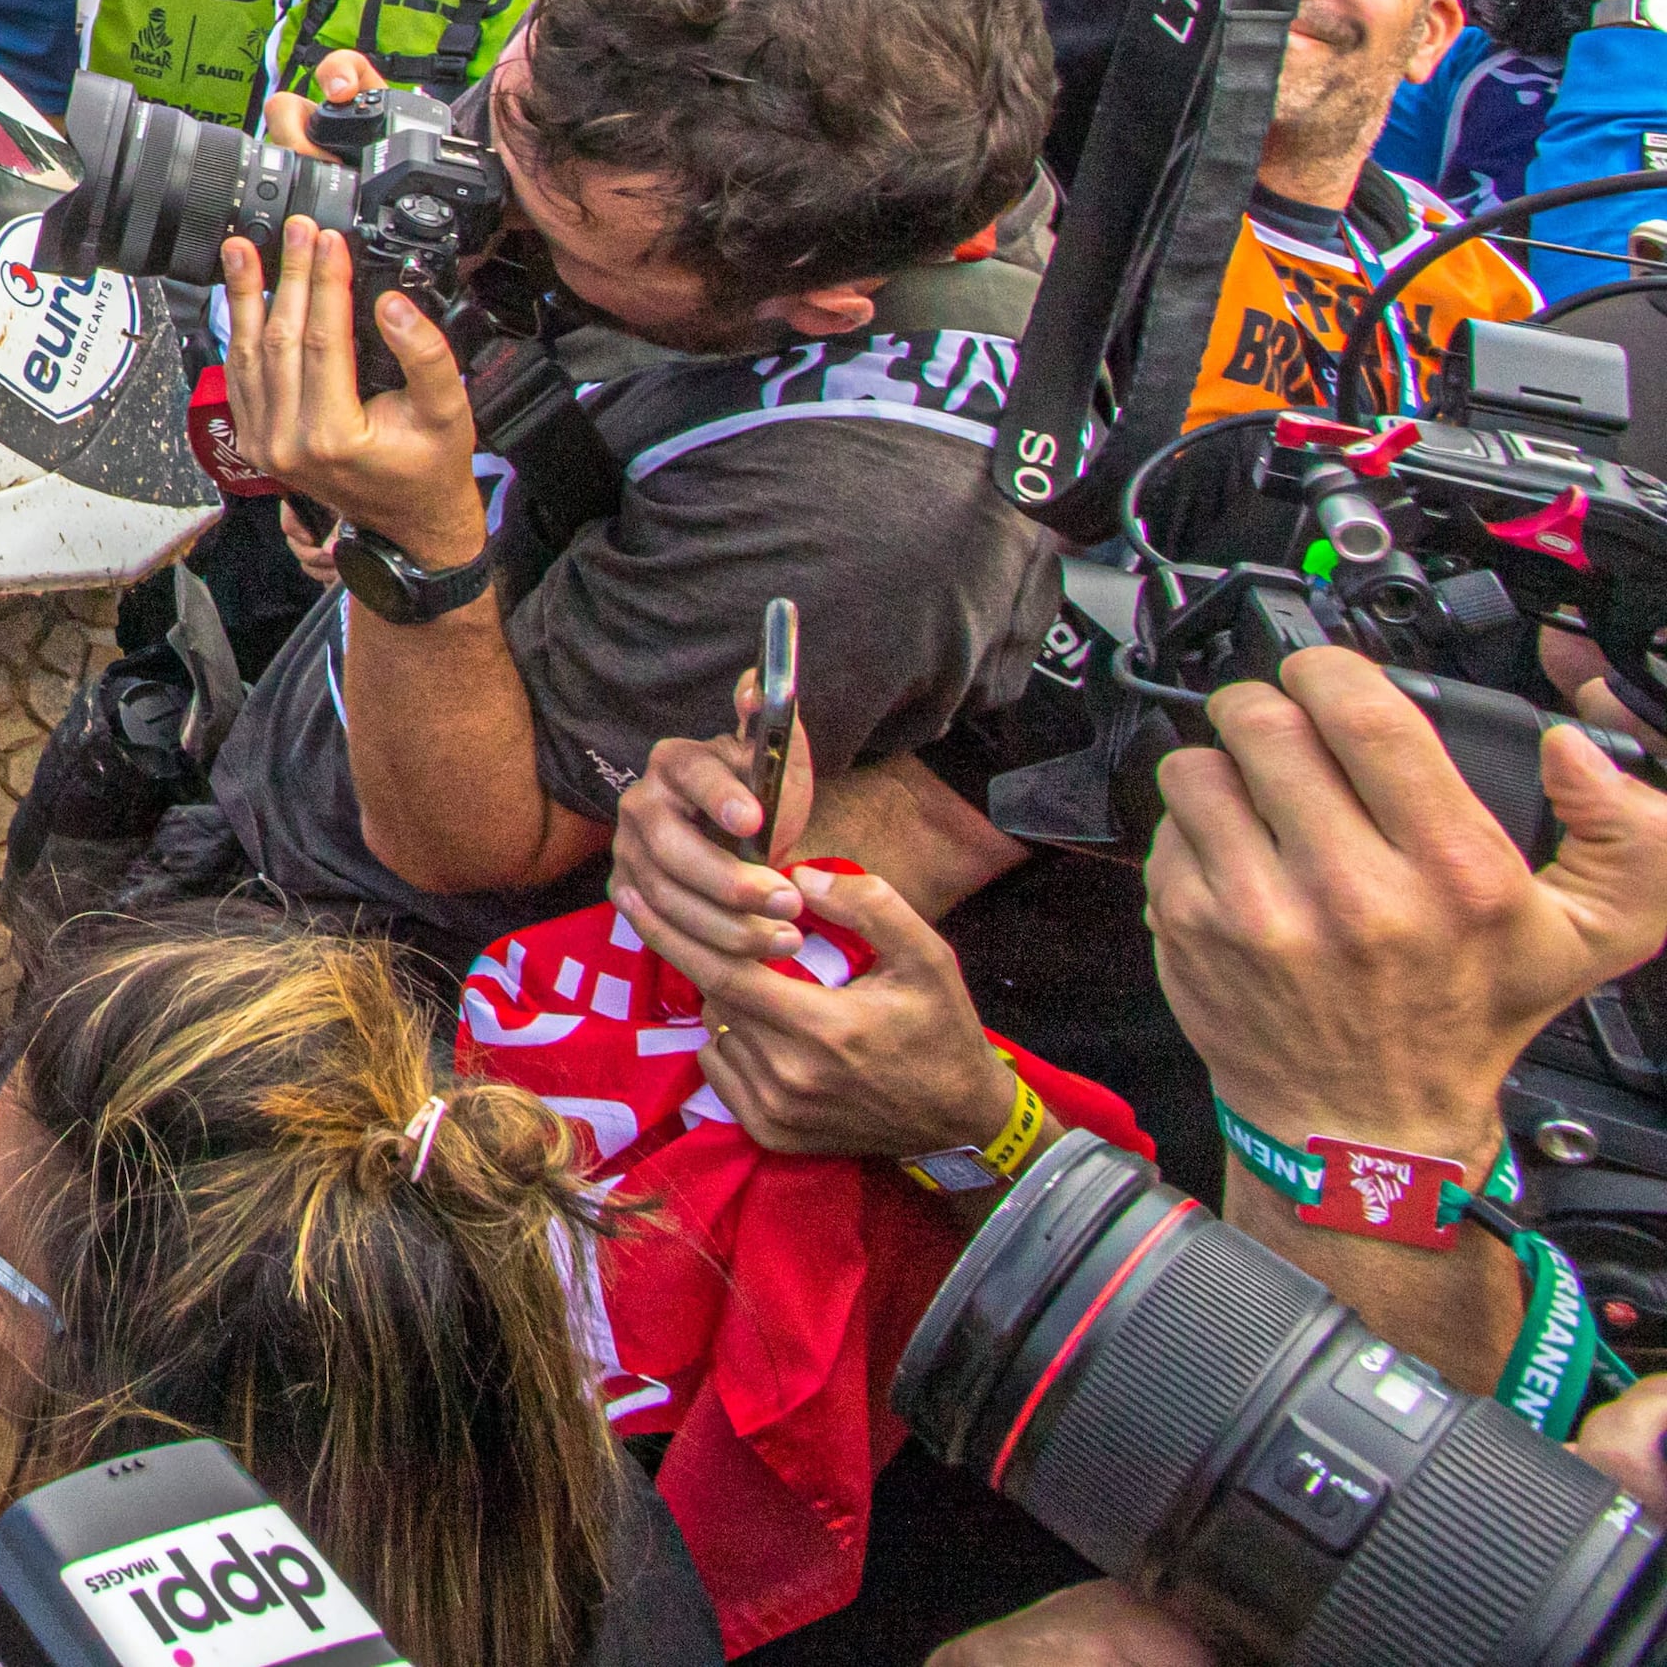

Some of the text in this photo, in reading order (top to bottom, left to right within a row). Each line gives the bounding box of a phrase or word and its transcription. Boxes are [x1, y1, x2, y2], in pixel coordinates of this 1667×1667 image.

[130, 42, 174, 71] DAKAR
[134, 65, 163, 79] 2023
[195, 63, 246, 82] SAUDI
[65, 279, 114, 389] LUBRICANTS
[1348, 1151, 1413, 1185] DAKAR
[86, 1556, 161, 1597] IMAGES
[130, 1530, 328, 1665] dppi
